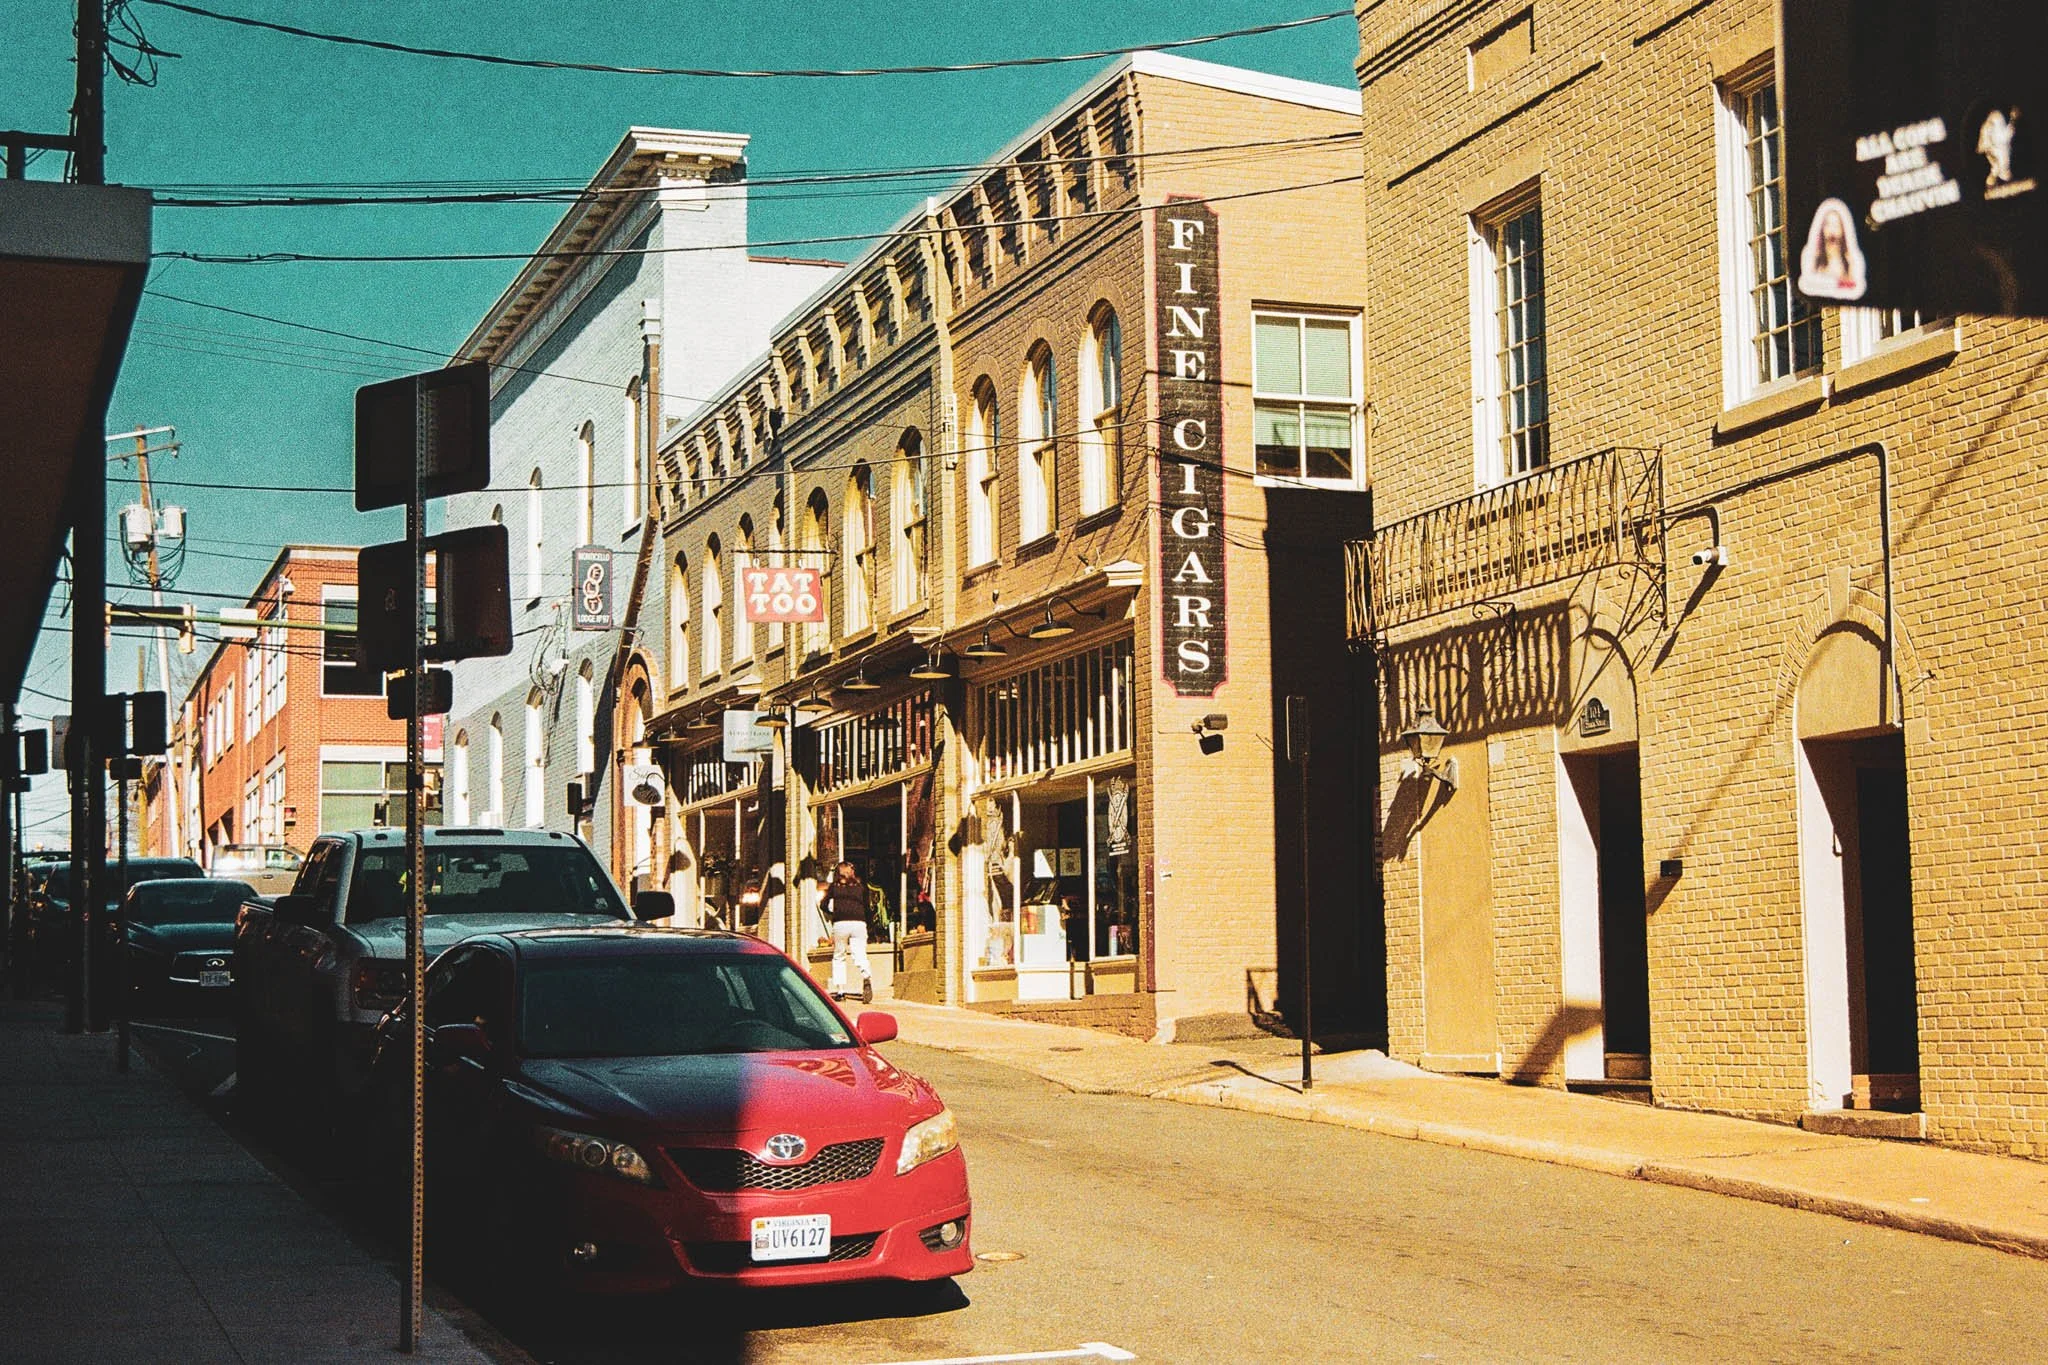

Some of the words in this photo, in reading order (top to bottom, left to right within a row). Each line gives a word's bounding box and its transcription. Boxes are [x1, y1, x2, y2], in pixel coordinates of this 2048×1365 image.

[1165, 217, 1211, 383] FINE
[1170, 418, 1217, 675] CIGARS
[747, 572, 814, 594] TAT
[748, 593, 818, 616] TOO
[773, 1217, 810, 1227] VIRGINIA
